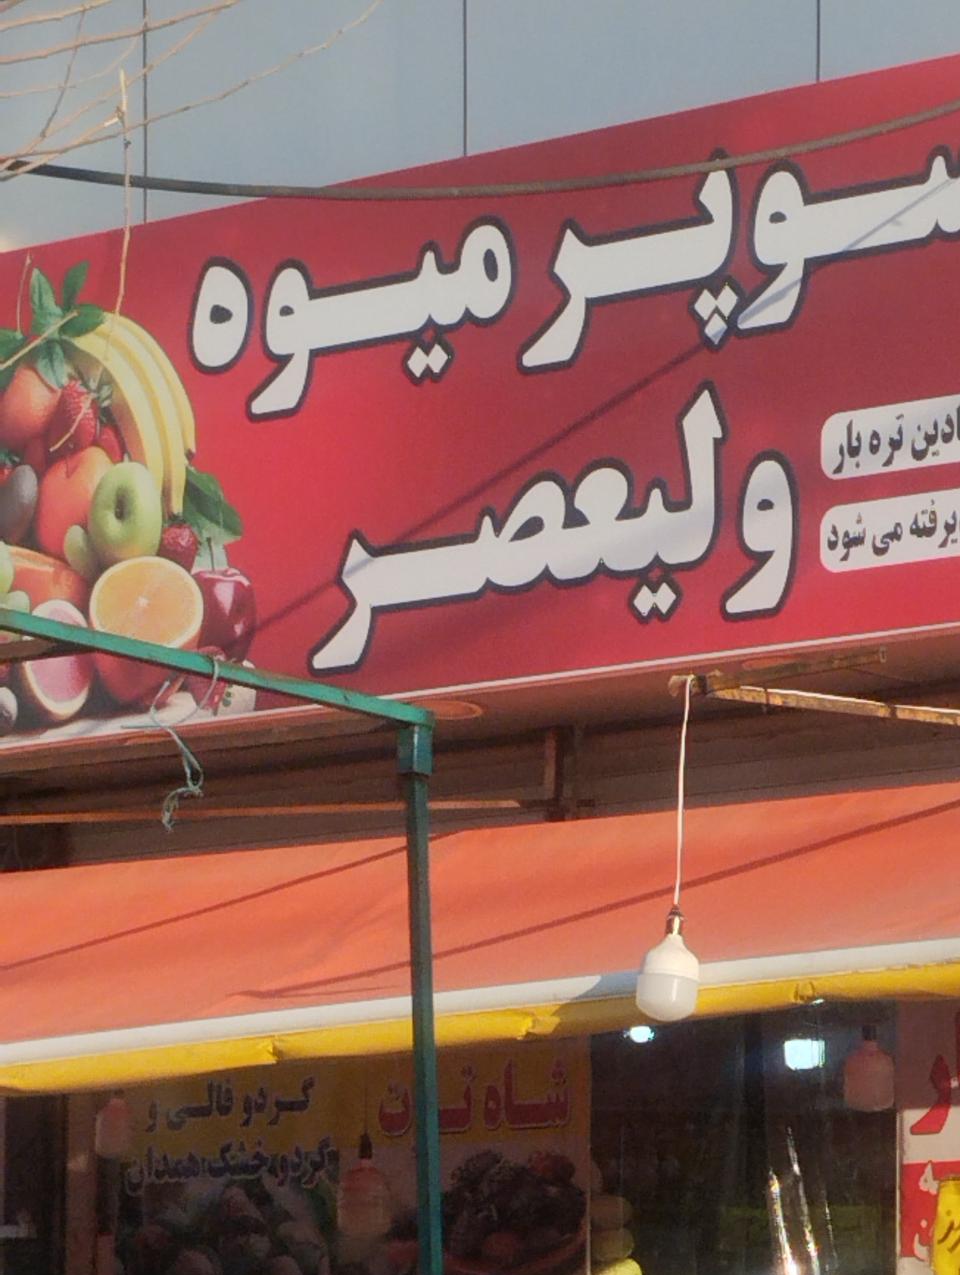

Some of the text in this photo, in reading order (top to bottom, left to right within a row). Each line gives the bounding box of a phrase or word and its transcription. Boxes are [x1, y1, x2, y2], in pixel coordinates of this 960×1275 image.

[191, 222, 514, 415] میوه
[832, 418, 863, 475] بار
[868, 413, 905, 467] تره
[310, 386, 797, 672] ولیعصر
[826, 513, 866, 562] شود
[240, 1076, 316, 1128] گردو
[484, 1058, 570, 1130] شاه
